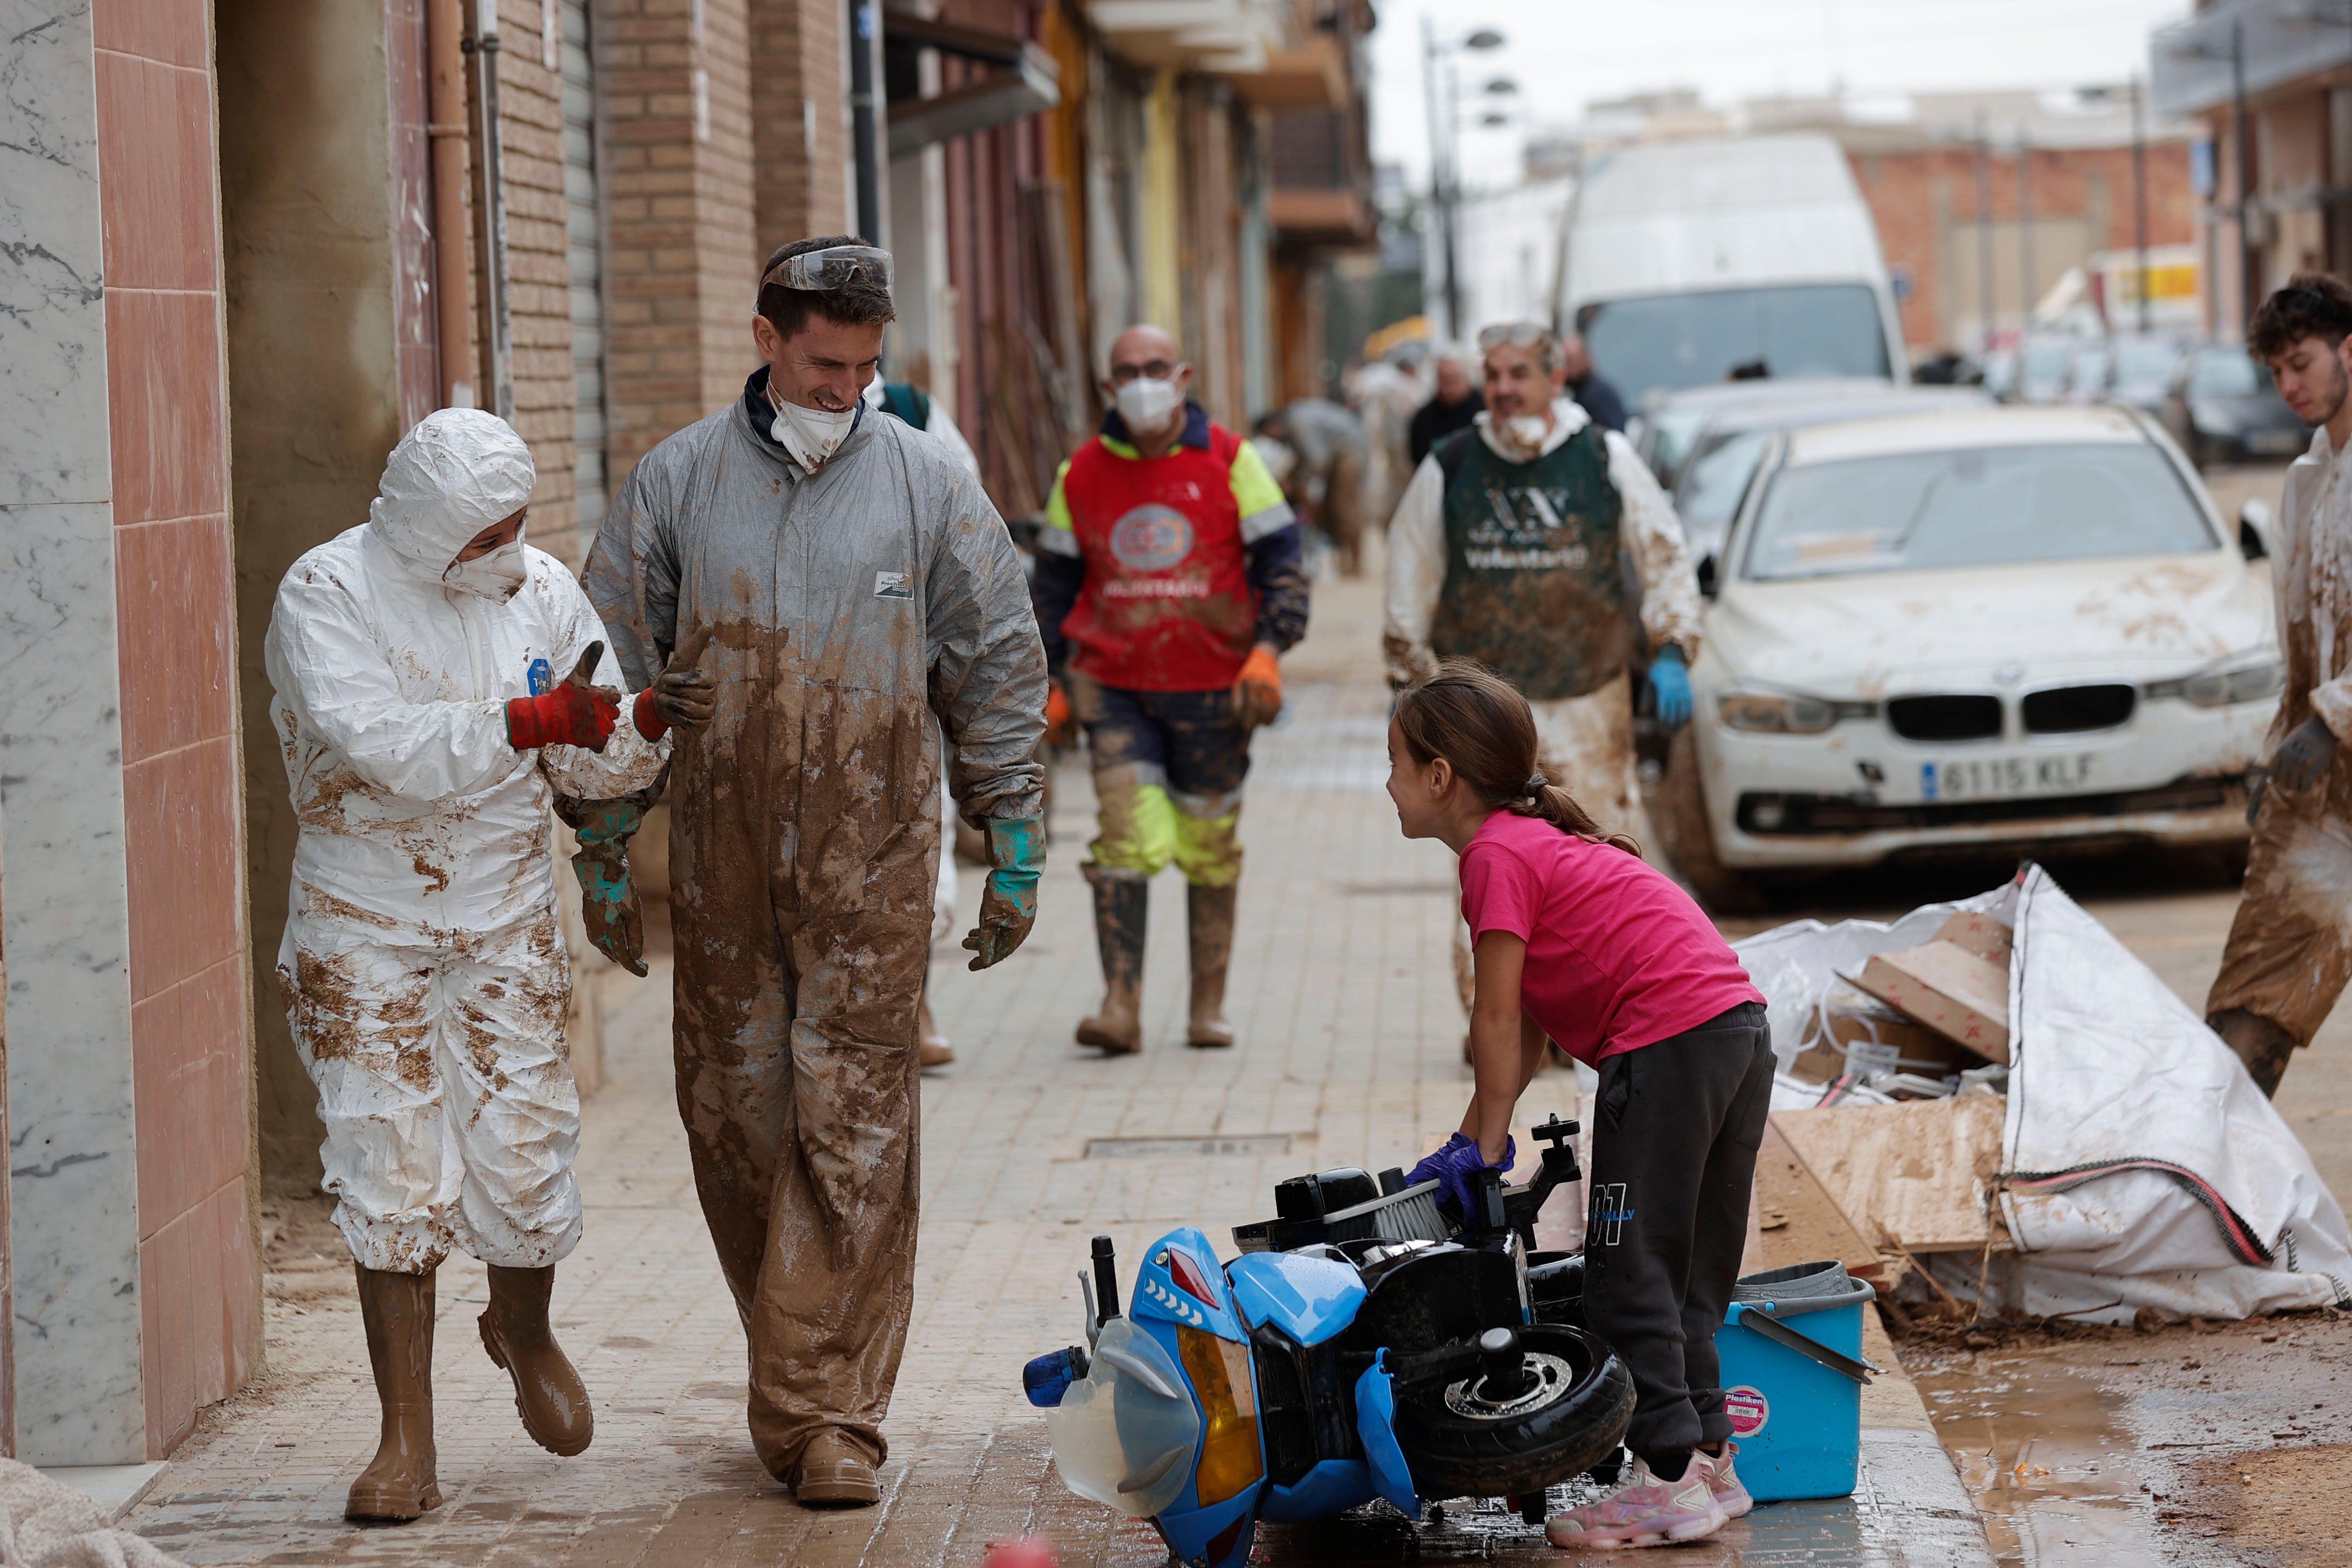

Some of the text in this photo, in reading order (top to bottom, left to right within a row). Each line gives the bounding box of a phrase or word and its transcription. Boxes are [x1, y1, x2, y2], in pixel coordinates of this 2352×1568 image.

[1943, 753, 2094, 794] 6115 KLF
[1726, 1394, 1763, 1405] Plastiken
